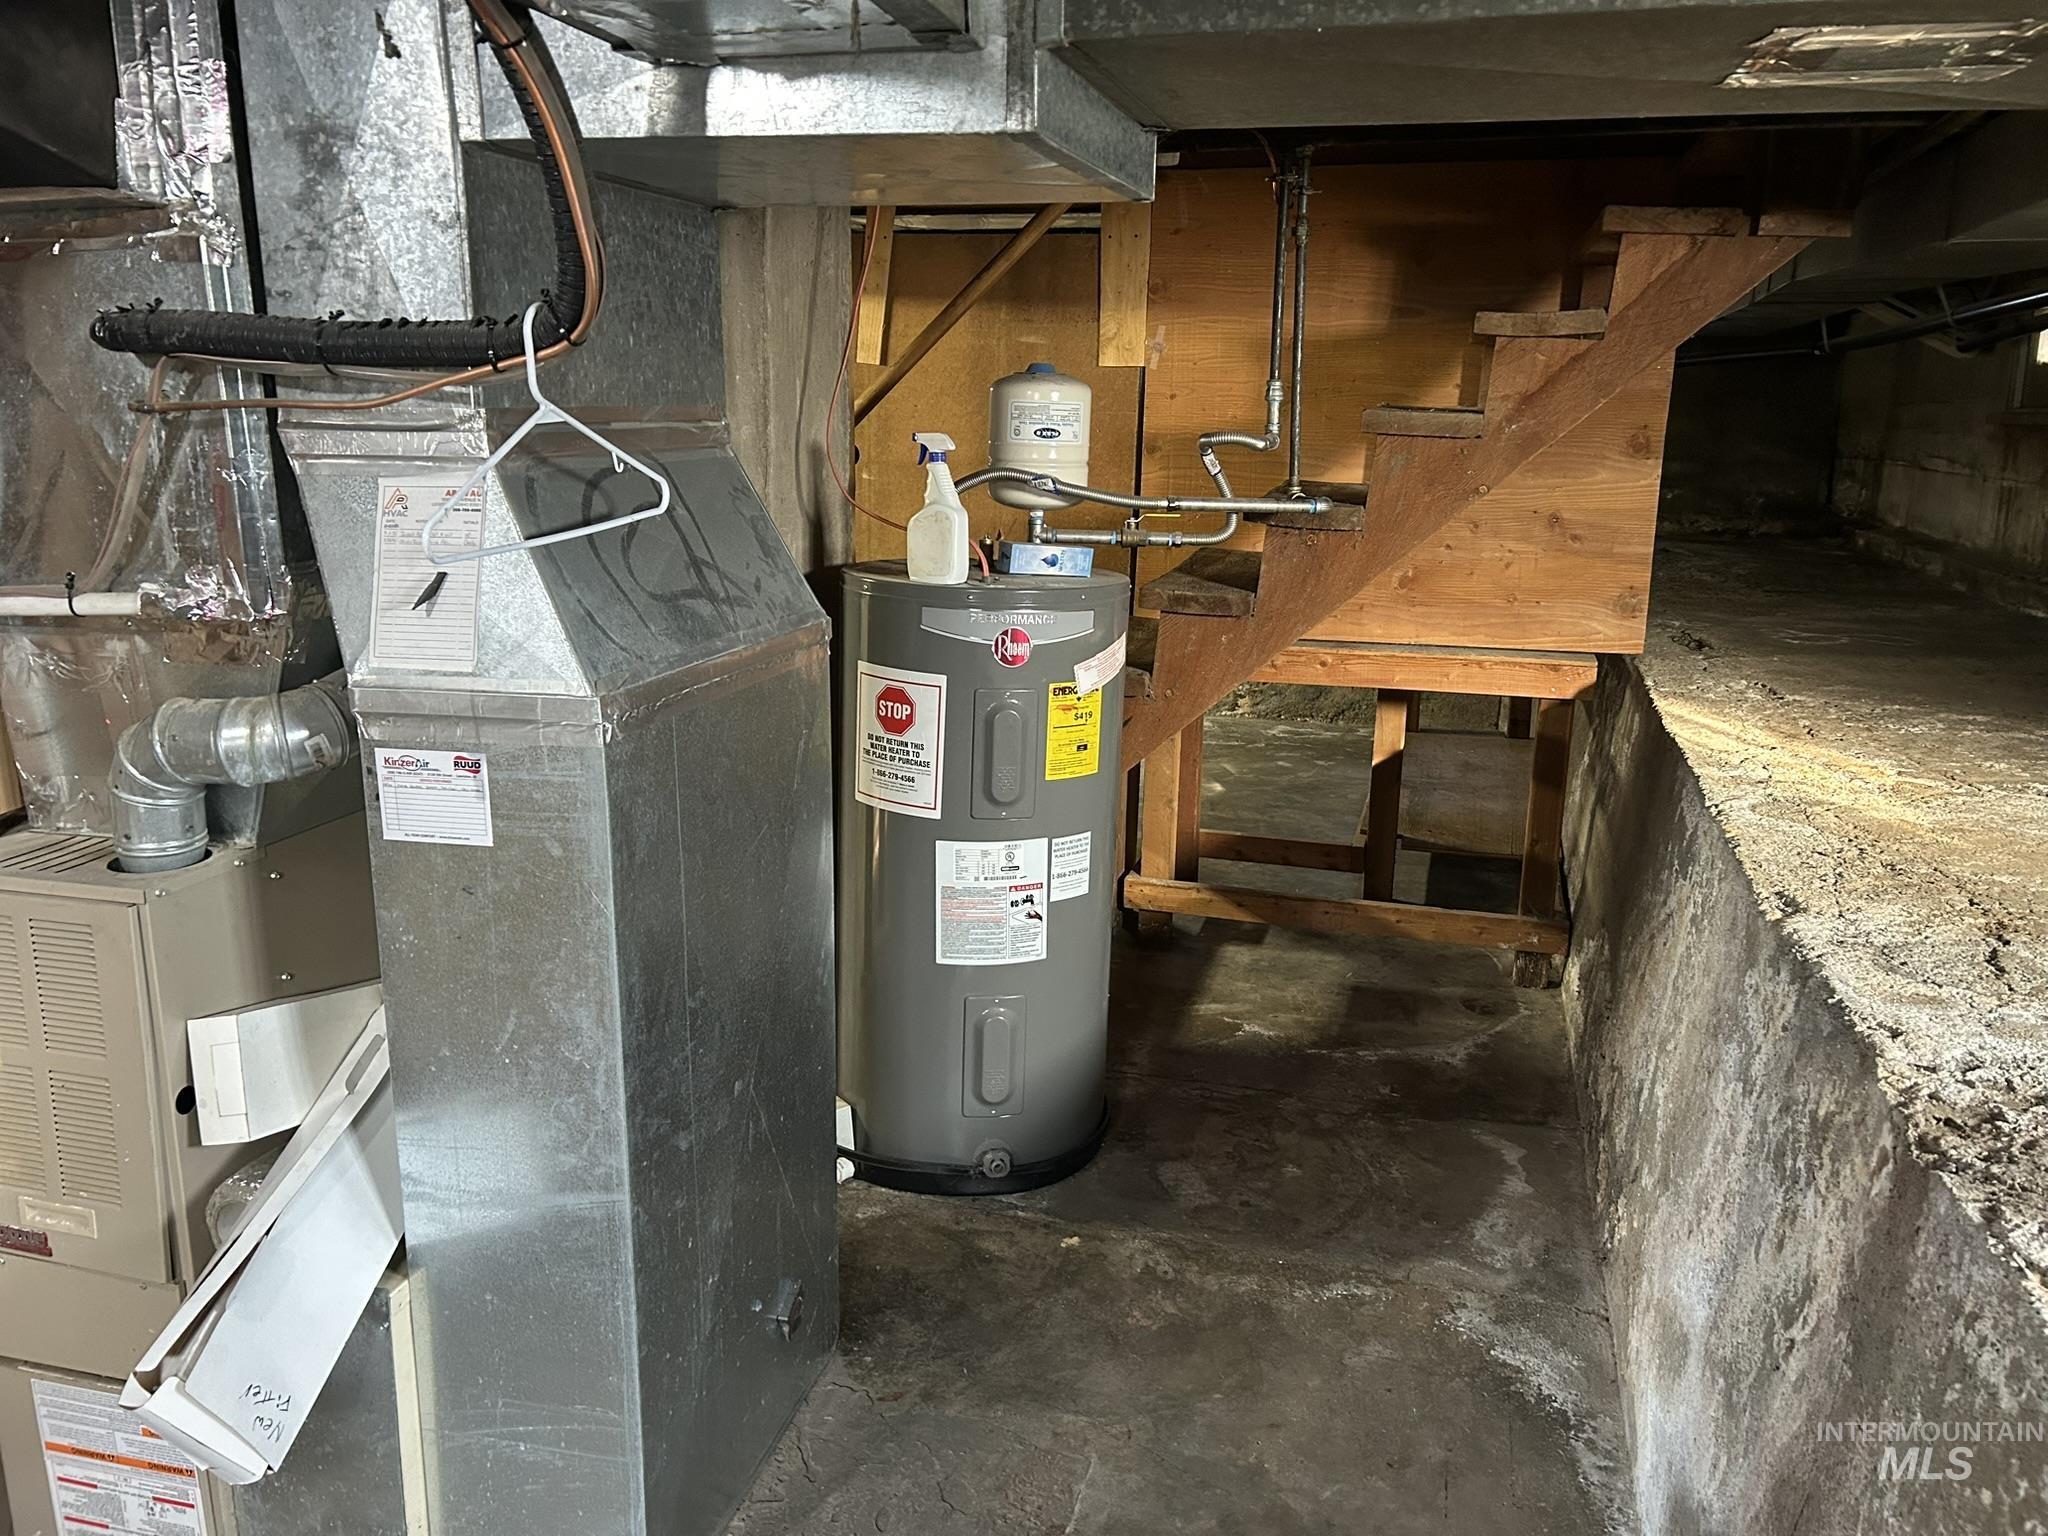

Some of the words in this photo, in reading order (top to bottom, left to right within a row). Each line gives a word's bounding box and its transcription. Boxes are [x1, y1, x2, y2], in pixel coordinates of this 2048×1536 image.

[970, 613, 1056, 625] PERFORMANCE
[998, 628, 1030, 661] Rheem
[878, 700, 912, 720] STOP
[867, 732, 874, 741] DO
[874, 735, 885, 744] NOT
[886, 738, 909, 749] RETURN
[910, 742, 925, 751] THIS
[870, 742, 887, 753] WATER
[888, 746, 911, 757] HEATER
[911, 750, 921, 759] TO
[454, 761, 481, 769] RUUD
[863, 747, 872, 757] THE
[872, 751, 889, 761] PLACE
[898, 757, 931, 769] PURCHASE
[252, 1415, 285, 1444] New
[147, 1461, 184, 1476] WARNING
